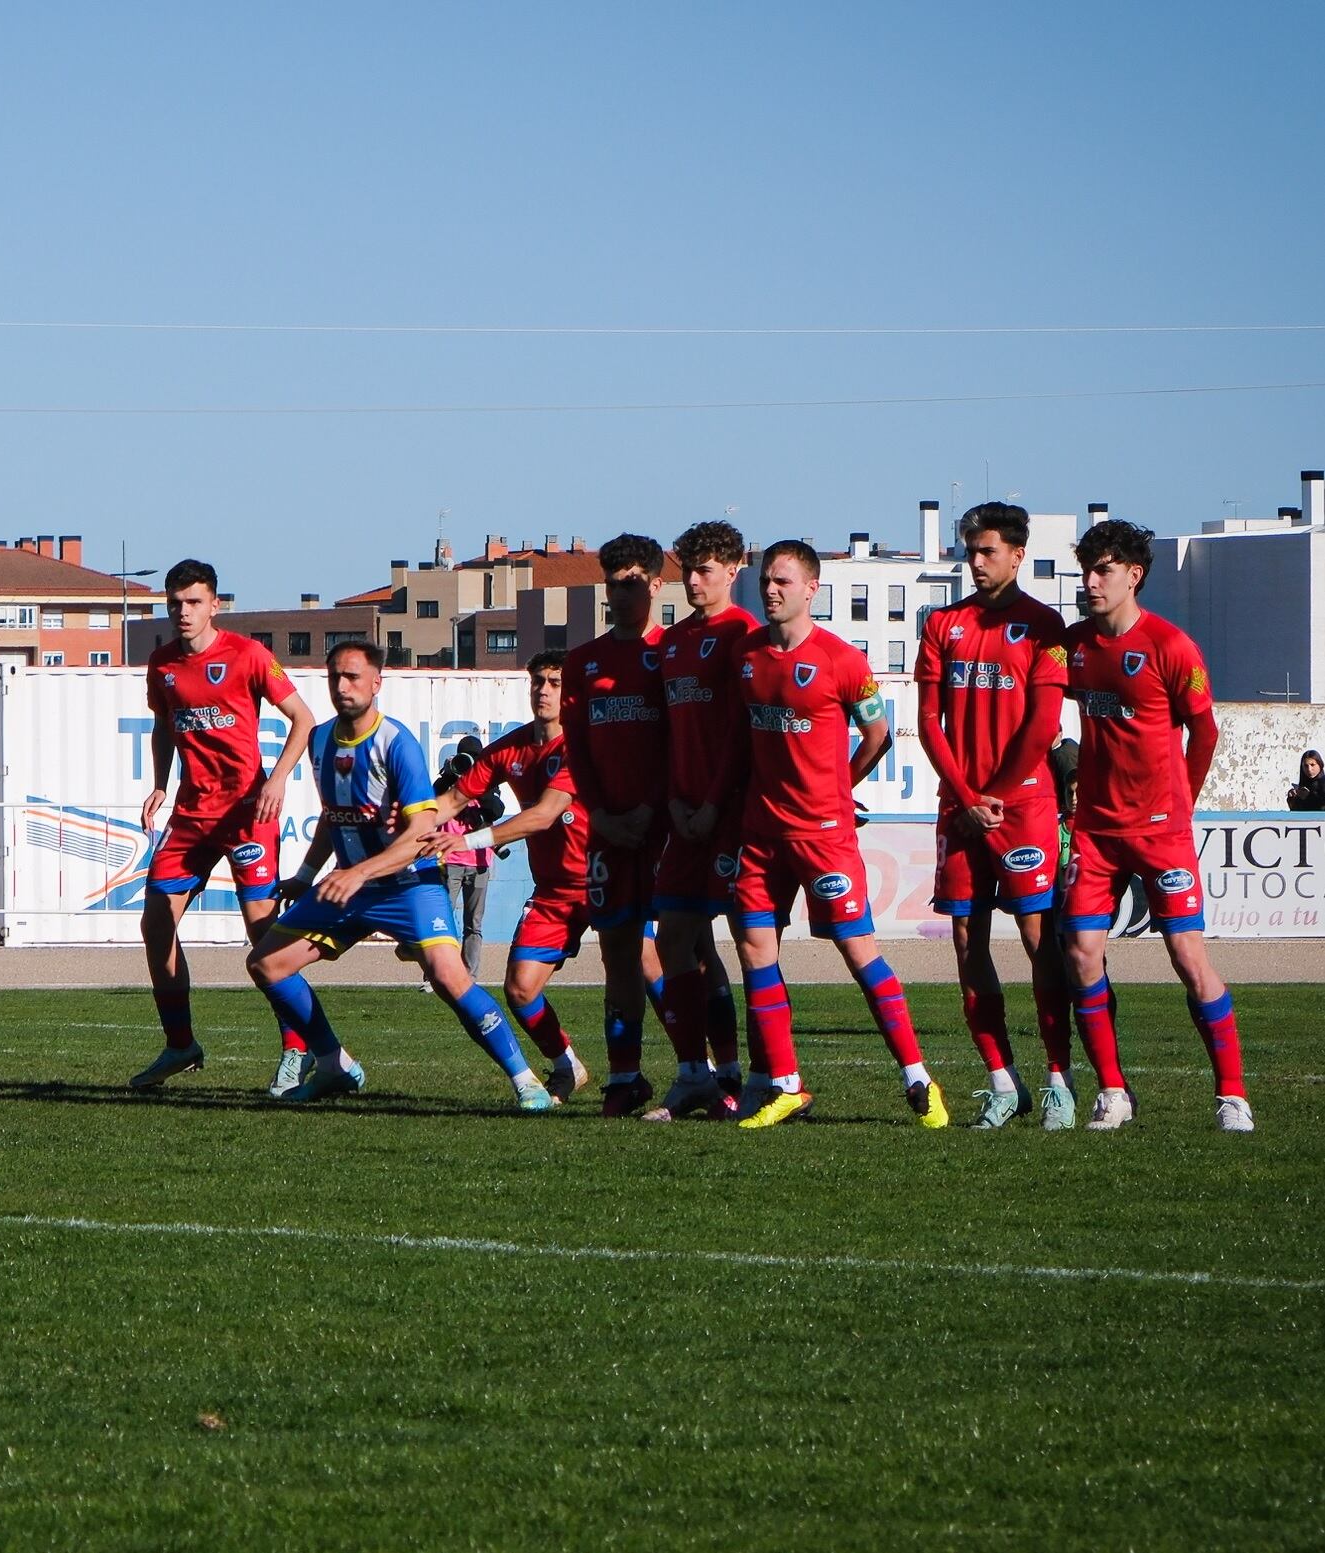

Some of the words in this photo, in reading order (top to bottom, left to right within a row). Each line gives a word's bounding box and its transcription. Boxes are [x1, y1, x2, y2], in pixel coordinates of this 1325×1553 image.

[967, 672, 1015, 690] erce
[607, 696, 644, 708] Grupo
[859, 697, 881, 721] C
[1207, 872, 1325, 899] UTOC
[1211, 903, 1261, 933] lujo
[1268, 909, 1284, 927] a
[1293, 906, 1319, 926] tu
